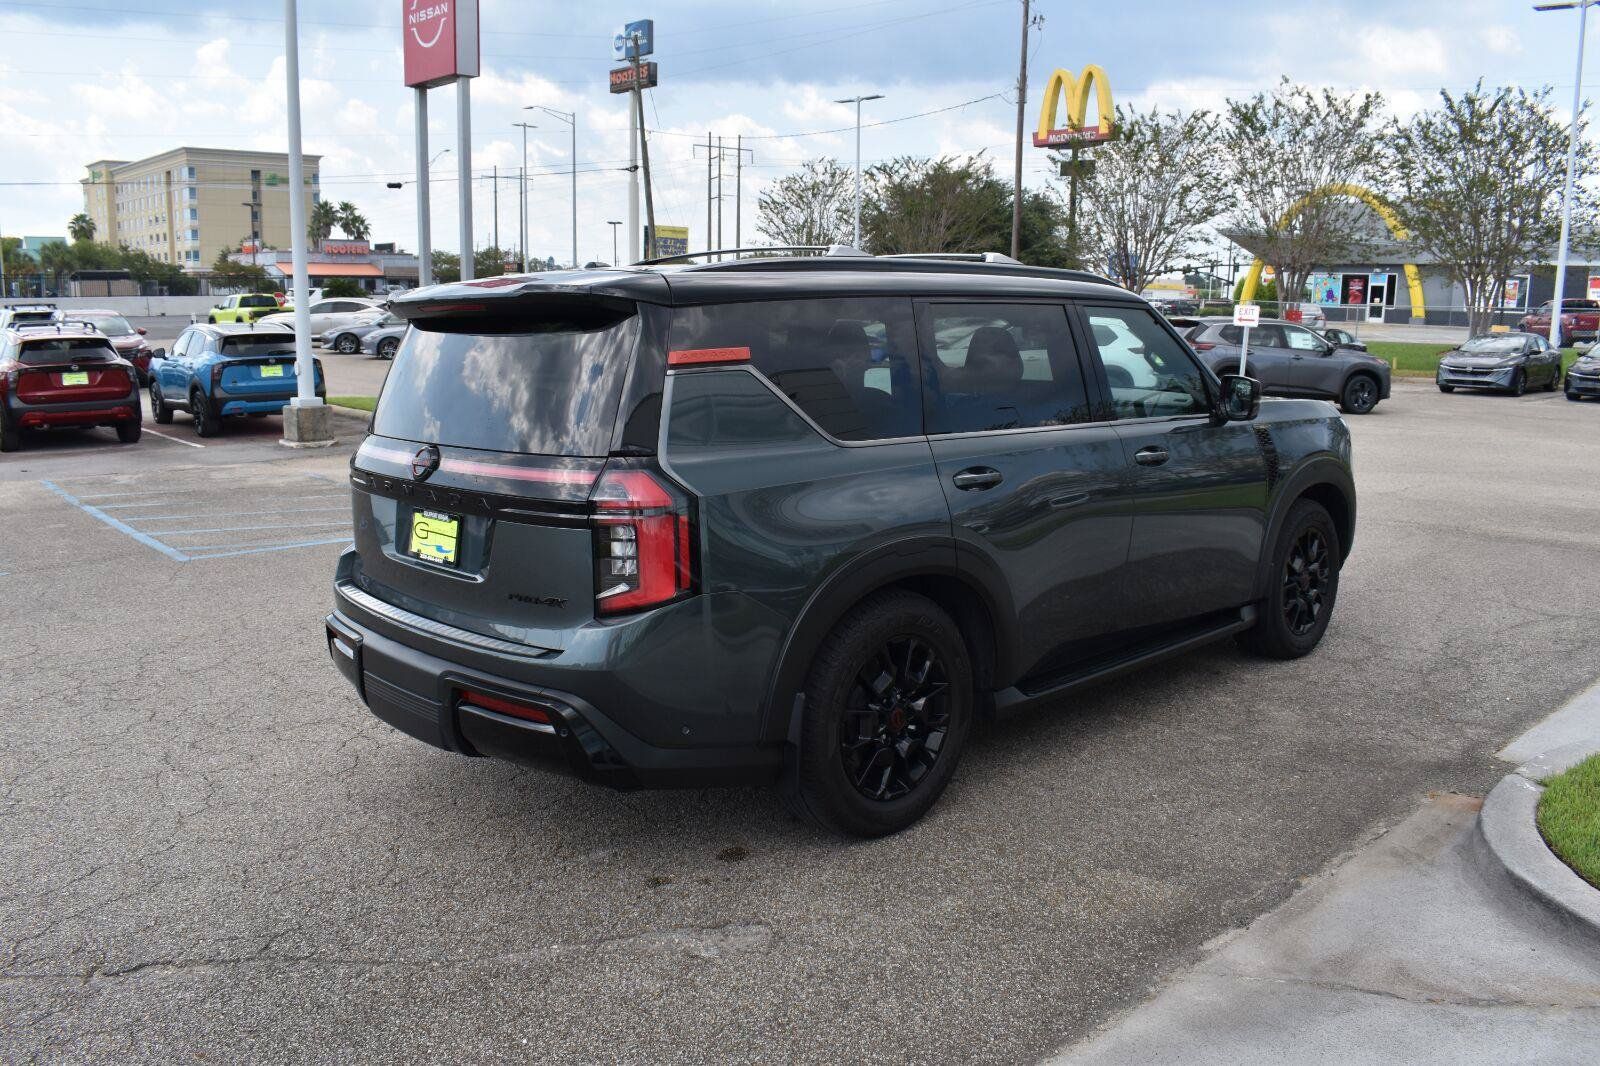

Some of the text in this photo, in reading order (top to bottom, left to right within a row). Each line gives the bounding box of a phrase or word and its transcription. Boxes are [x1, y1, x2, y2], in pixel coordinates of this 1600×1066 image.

[408, 2, 449, 25] NISSAN
[325, 243, 370, 255] HOOTERS
[1238, 307, 1255, 316] EXIT
[368, 476, 492, 511] ARMADA
